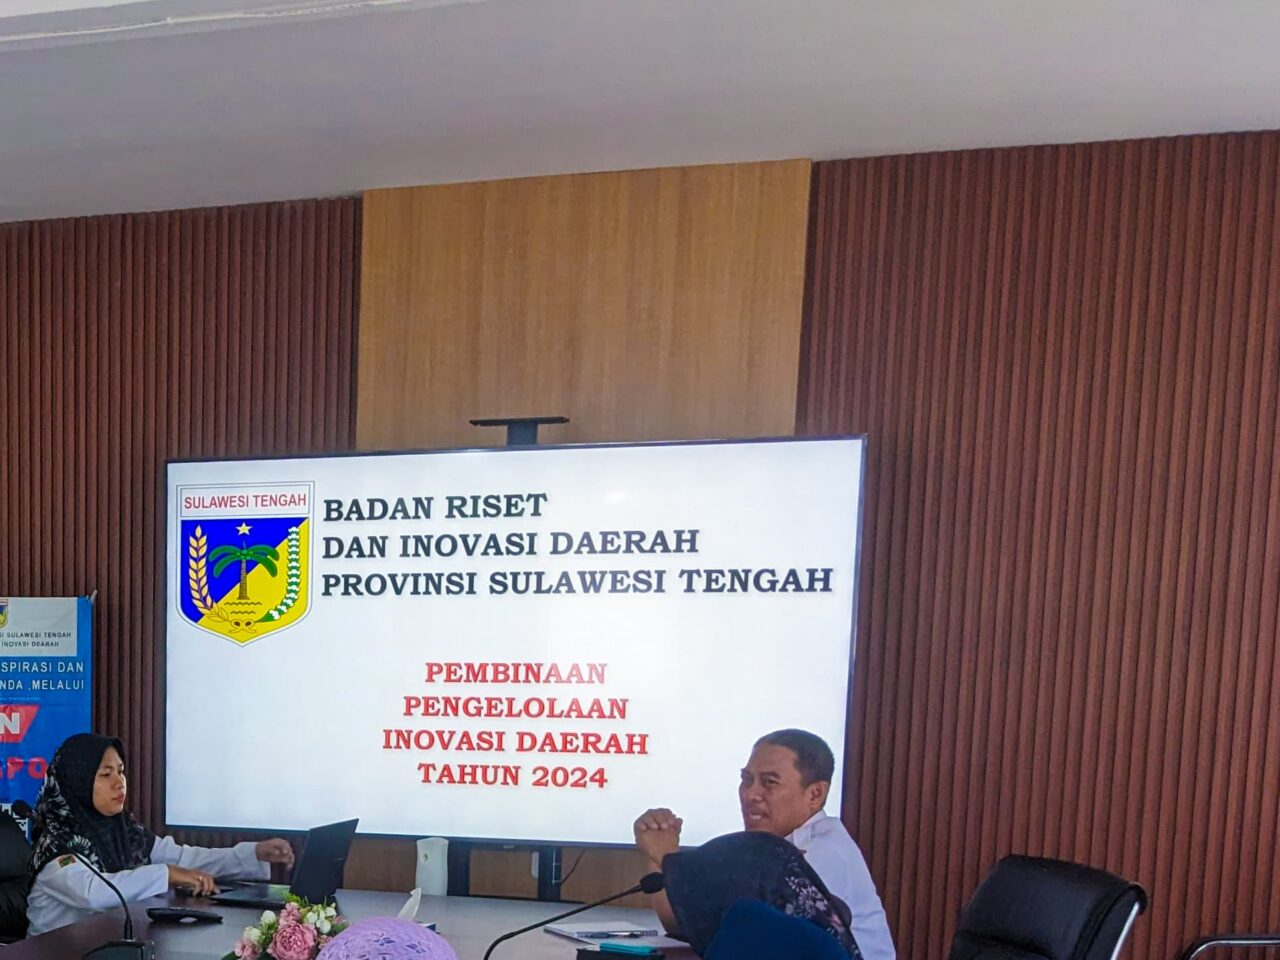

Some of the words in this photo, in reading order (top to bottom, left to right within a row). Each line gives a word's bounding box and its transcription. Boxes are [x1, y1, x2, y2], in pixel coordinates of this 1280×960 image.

[184, 494, 250, 510] SULAWESI
[253, 493, 307, 508] TENGAH
[323, 496, 434, 522] BADAN
[445, 493, 548, 519] RISET
[322, 536, 388, 559] DAN
[399, 532, 538, 558] INOVASI
[549, 529, 700, 555] DAERAH
[321, 572, 477, 597] PROVINSI
[489, 569, 666, 595] SULAWESI
[679, 568, 833, 593] TENGAH
[7, 631, 42, 639] SULAWESI
[44, 631, 72, 639] TENGAH
[57, 661, 84, 673] DAN
[425, 662, 608, 684] PEMBINAAN
[403, 696, 629, 719] PENGELOLAAN
[382, 729, 505, 752] INOVASI
[515, 732, 649, 755] DAERAH
[417, 763, 521, 786] TAHUN
[532, 766, 608, 788] 2024
